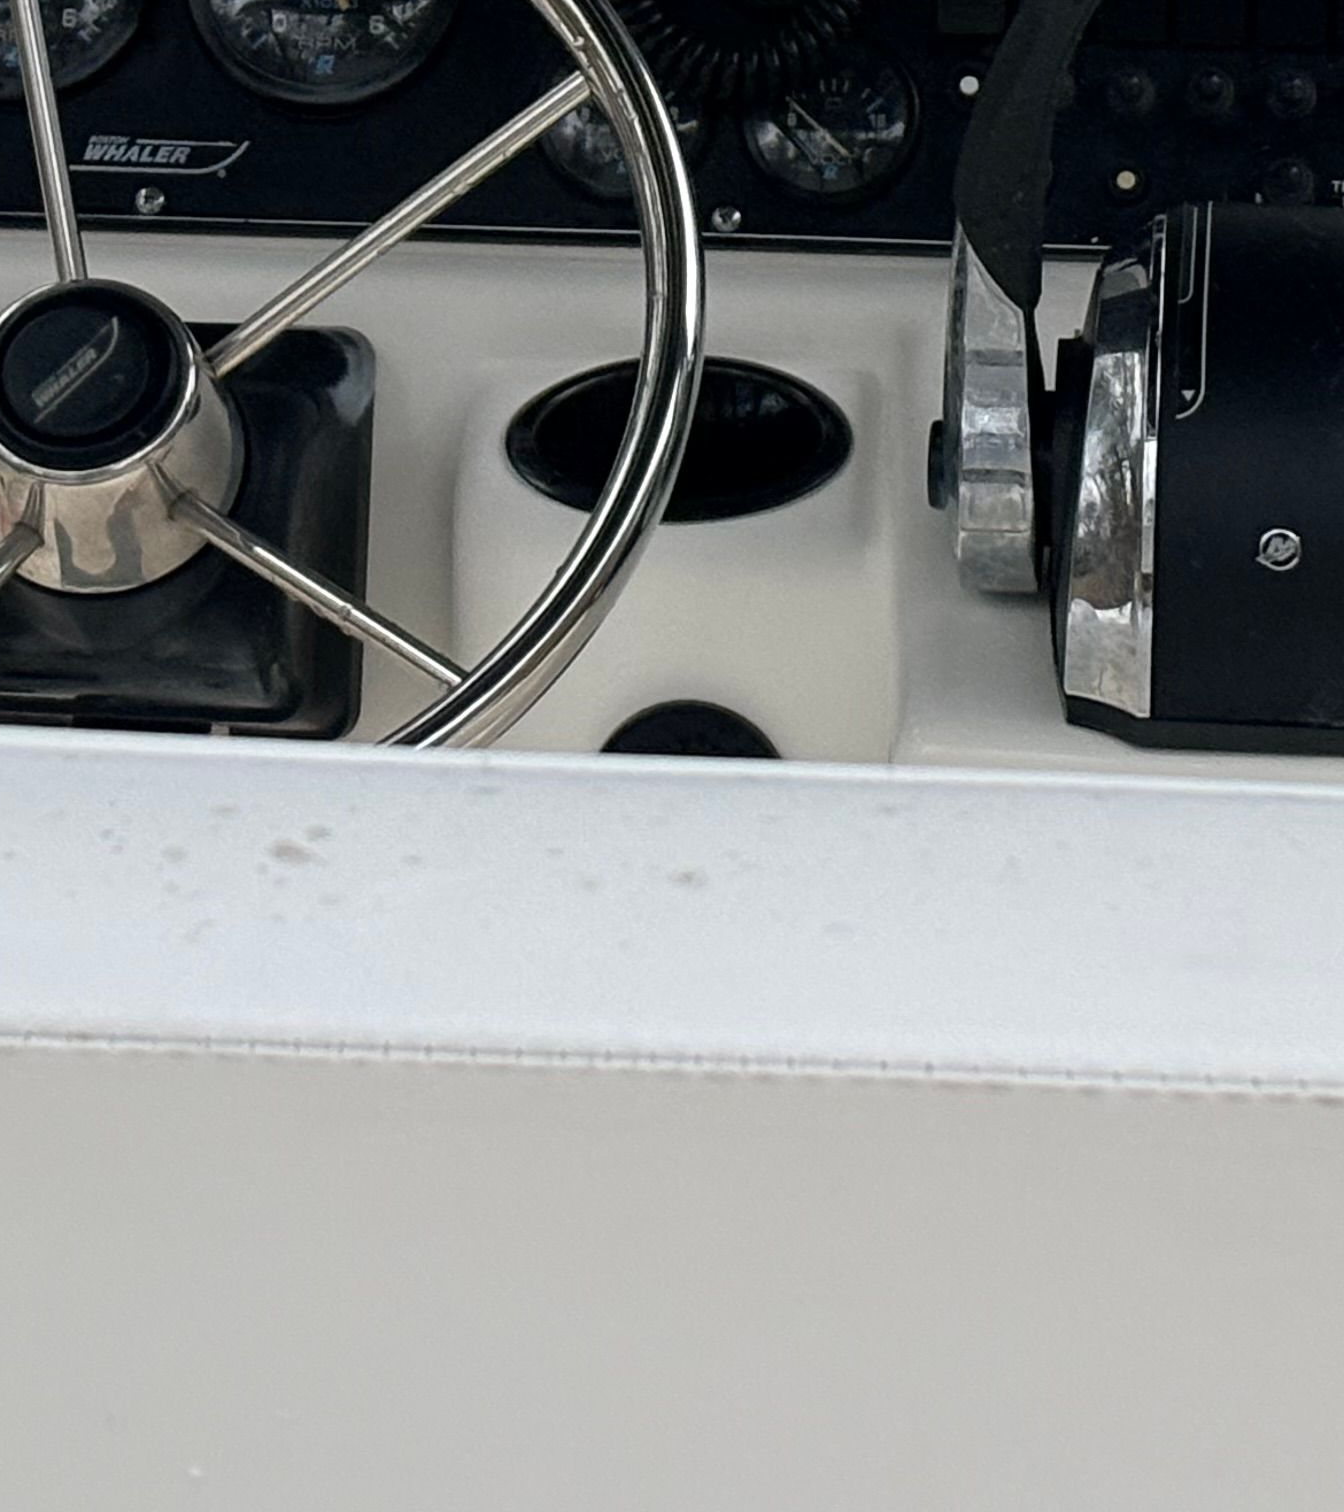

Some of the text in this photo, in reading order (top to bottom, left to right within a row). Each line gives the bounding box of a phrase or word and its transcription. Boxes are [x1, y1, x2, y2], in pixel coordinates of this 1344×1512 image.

[62, 8, 77, 28] 6
[369, 14, 385, 35] 6
[83, 144, 192, 165] WHALER
